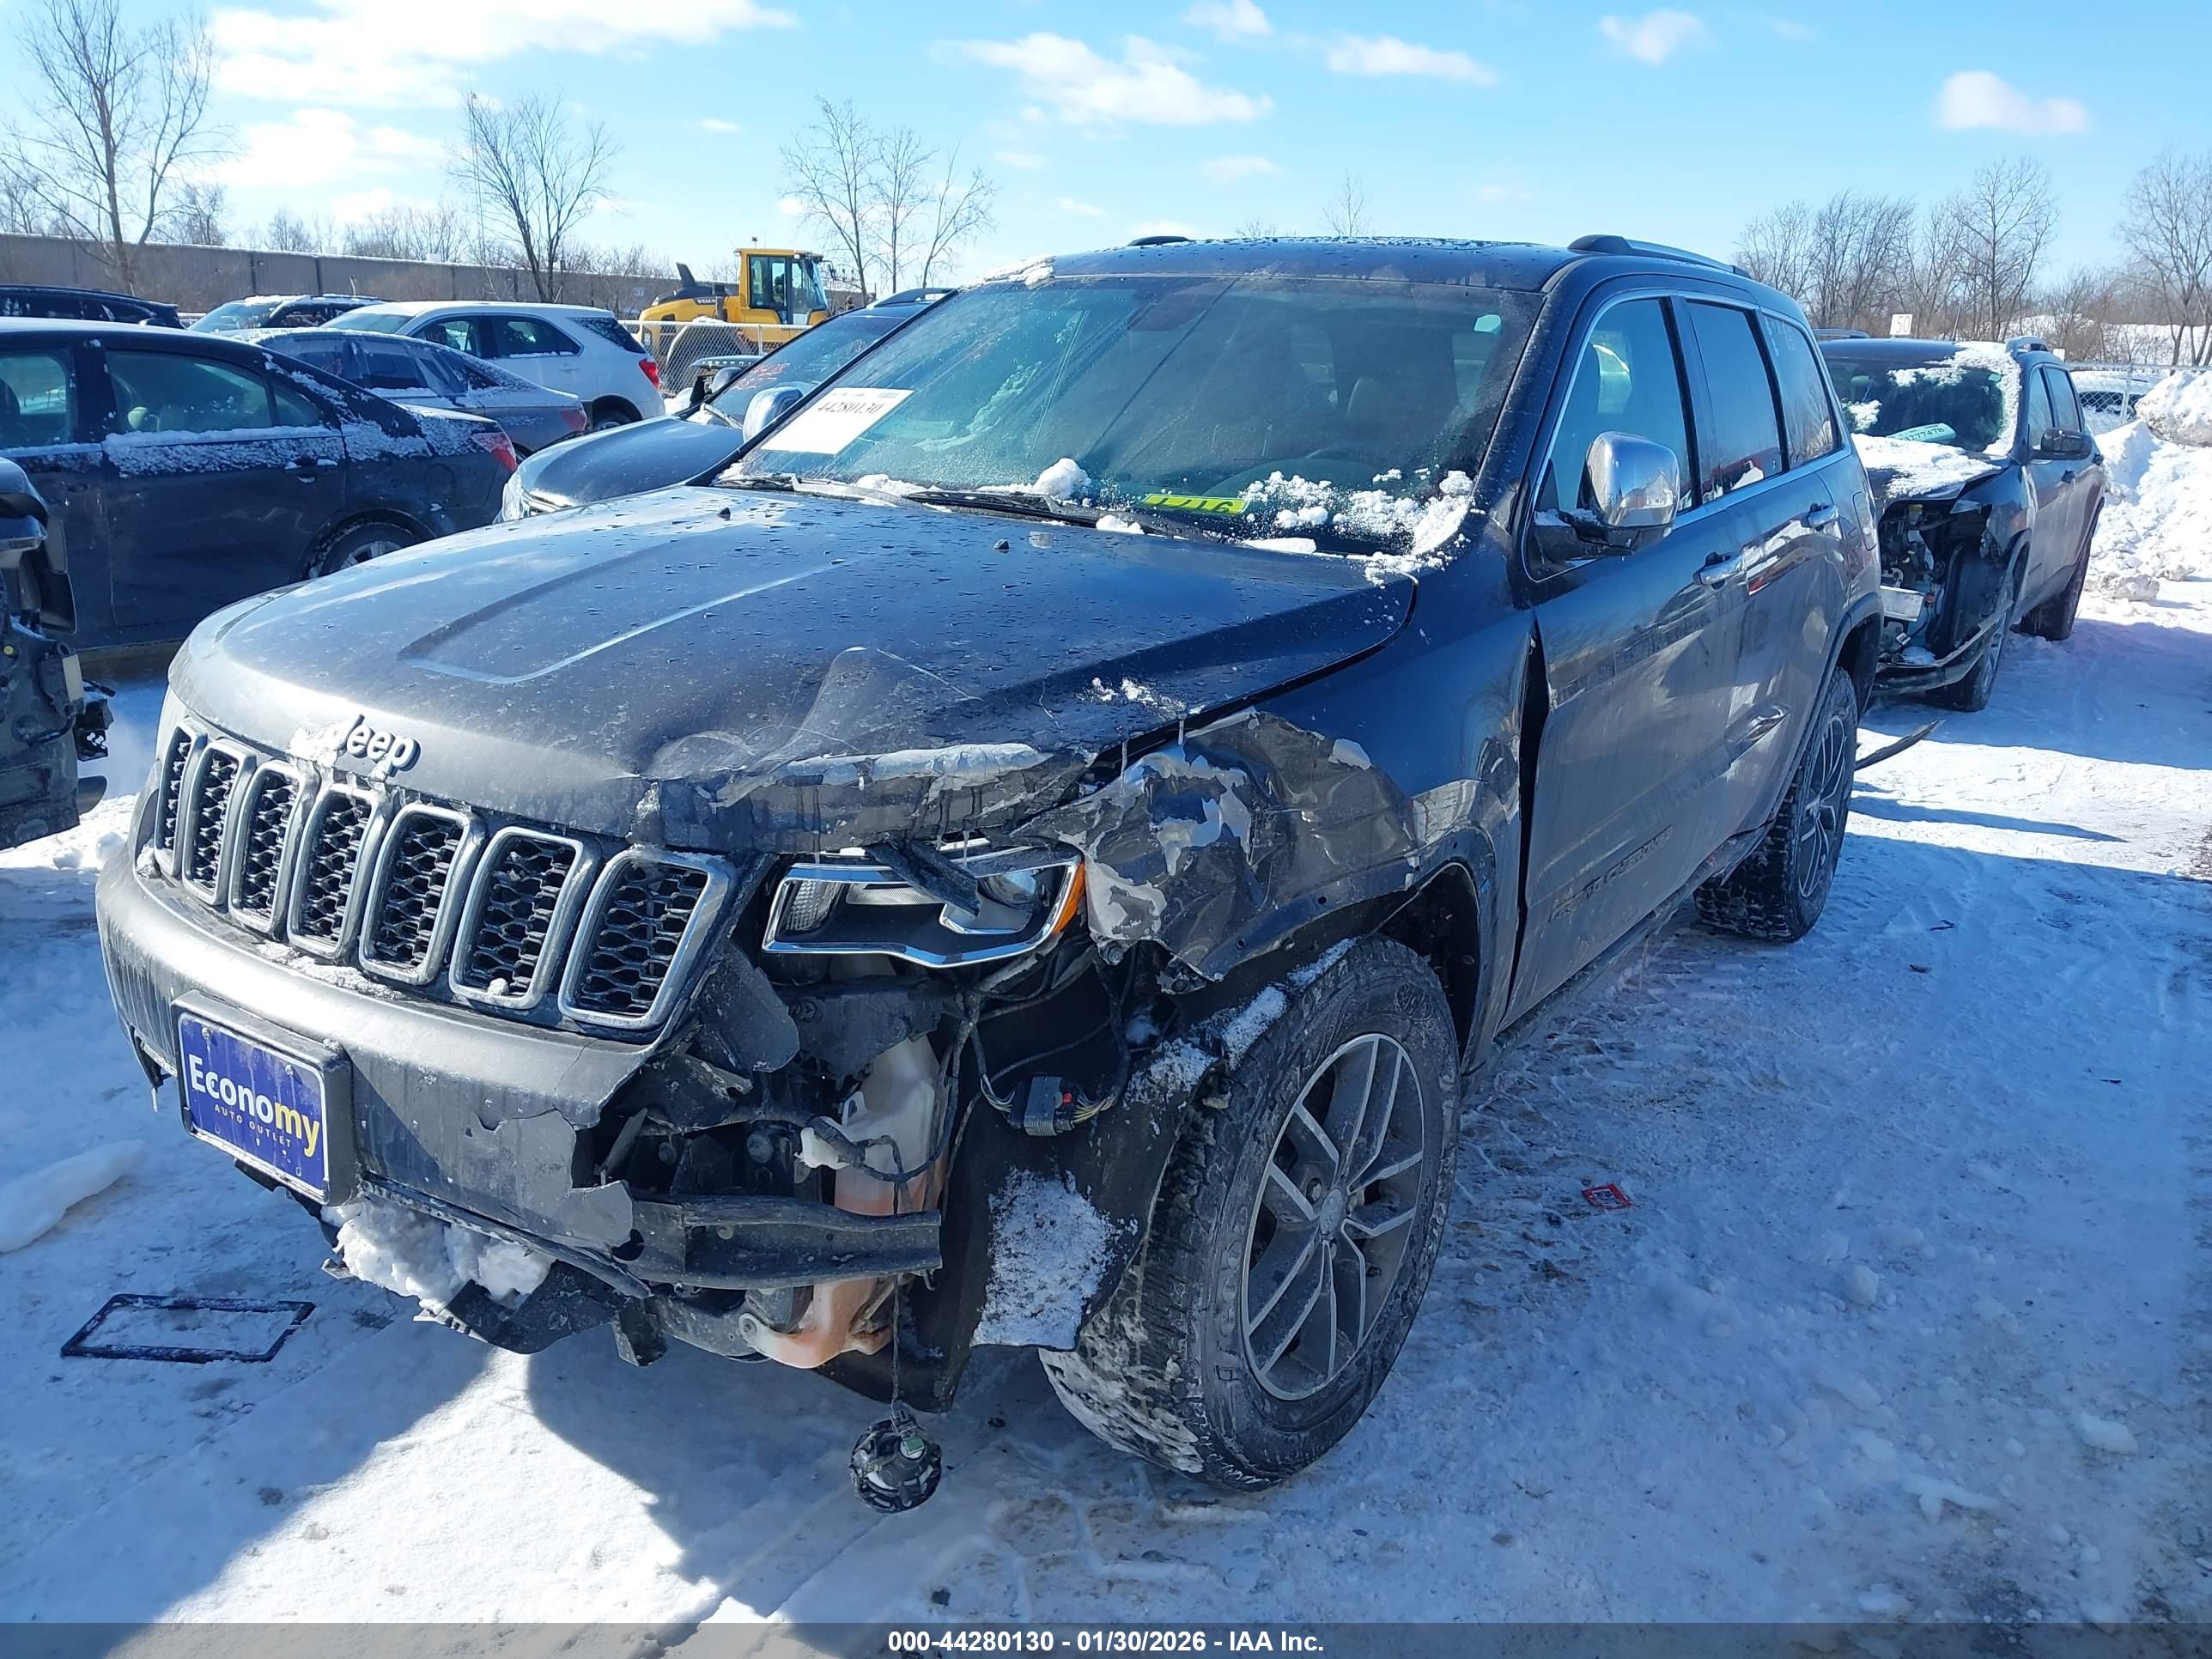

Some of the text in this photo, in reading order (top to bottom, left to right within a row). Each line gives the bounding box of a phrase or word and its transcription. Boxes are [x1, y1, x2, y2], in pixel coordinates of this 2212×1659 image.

[817, 400, 884, 414] 44280130
[333, 714, 422, 778] Jeep
[188, 1053, 320, 1158] Economy
[215, 1104, 291, 1148] AUTO OUTLET
